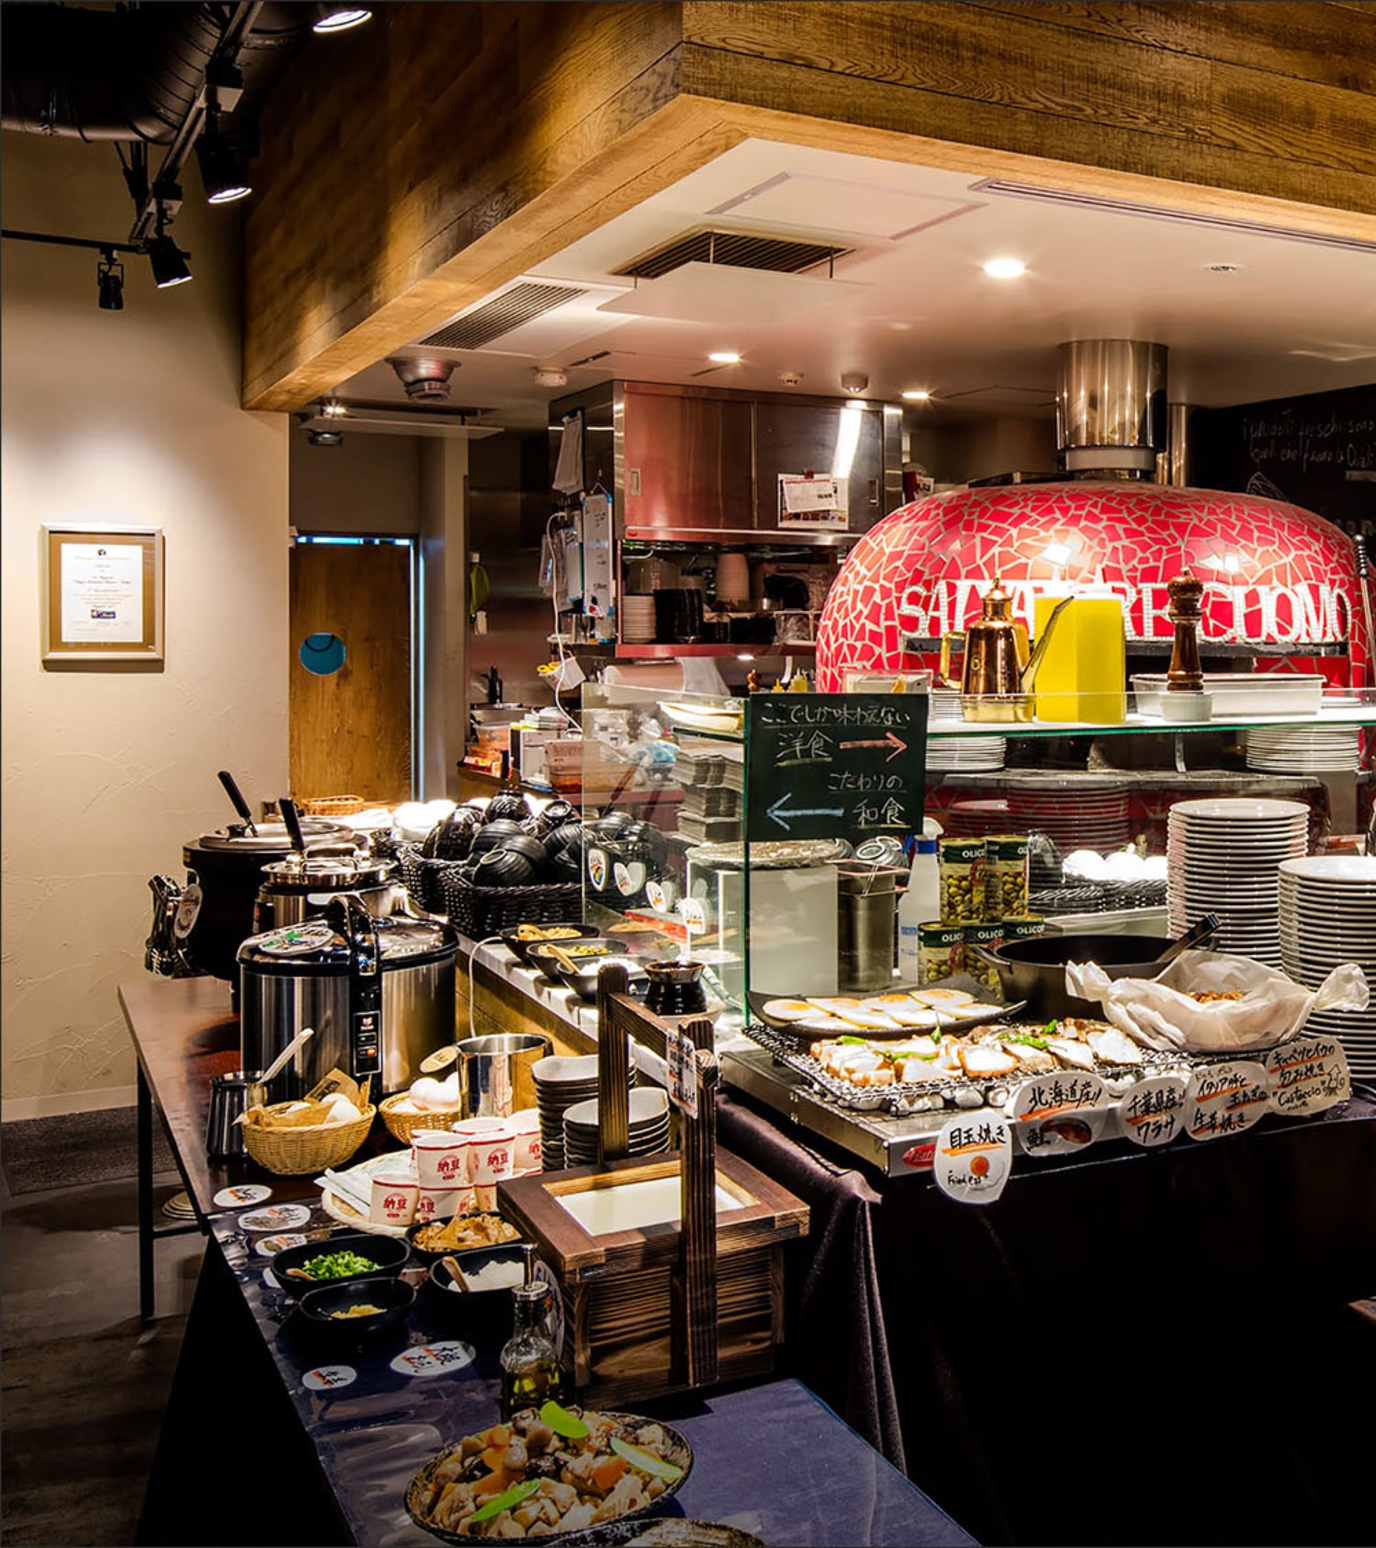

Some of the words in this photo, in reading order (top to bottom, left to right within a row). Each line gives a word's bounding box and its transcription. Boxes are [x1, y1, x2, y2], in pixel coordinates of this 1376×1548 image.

[776, 730, 834, 759] 洋食
[827, 770, 902, 792] こだわりの
[852, 797, 906, 827] 和食
[949, 1124, 1007, 1150] 目玉焼き
[436, 1157, 461, 1173] 納豆
[383, 1197, 408, 1211] 納豆
